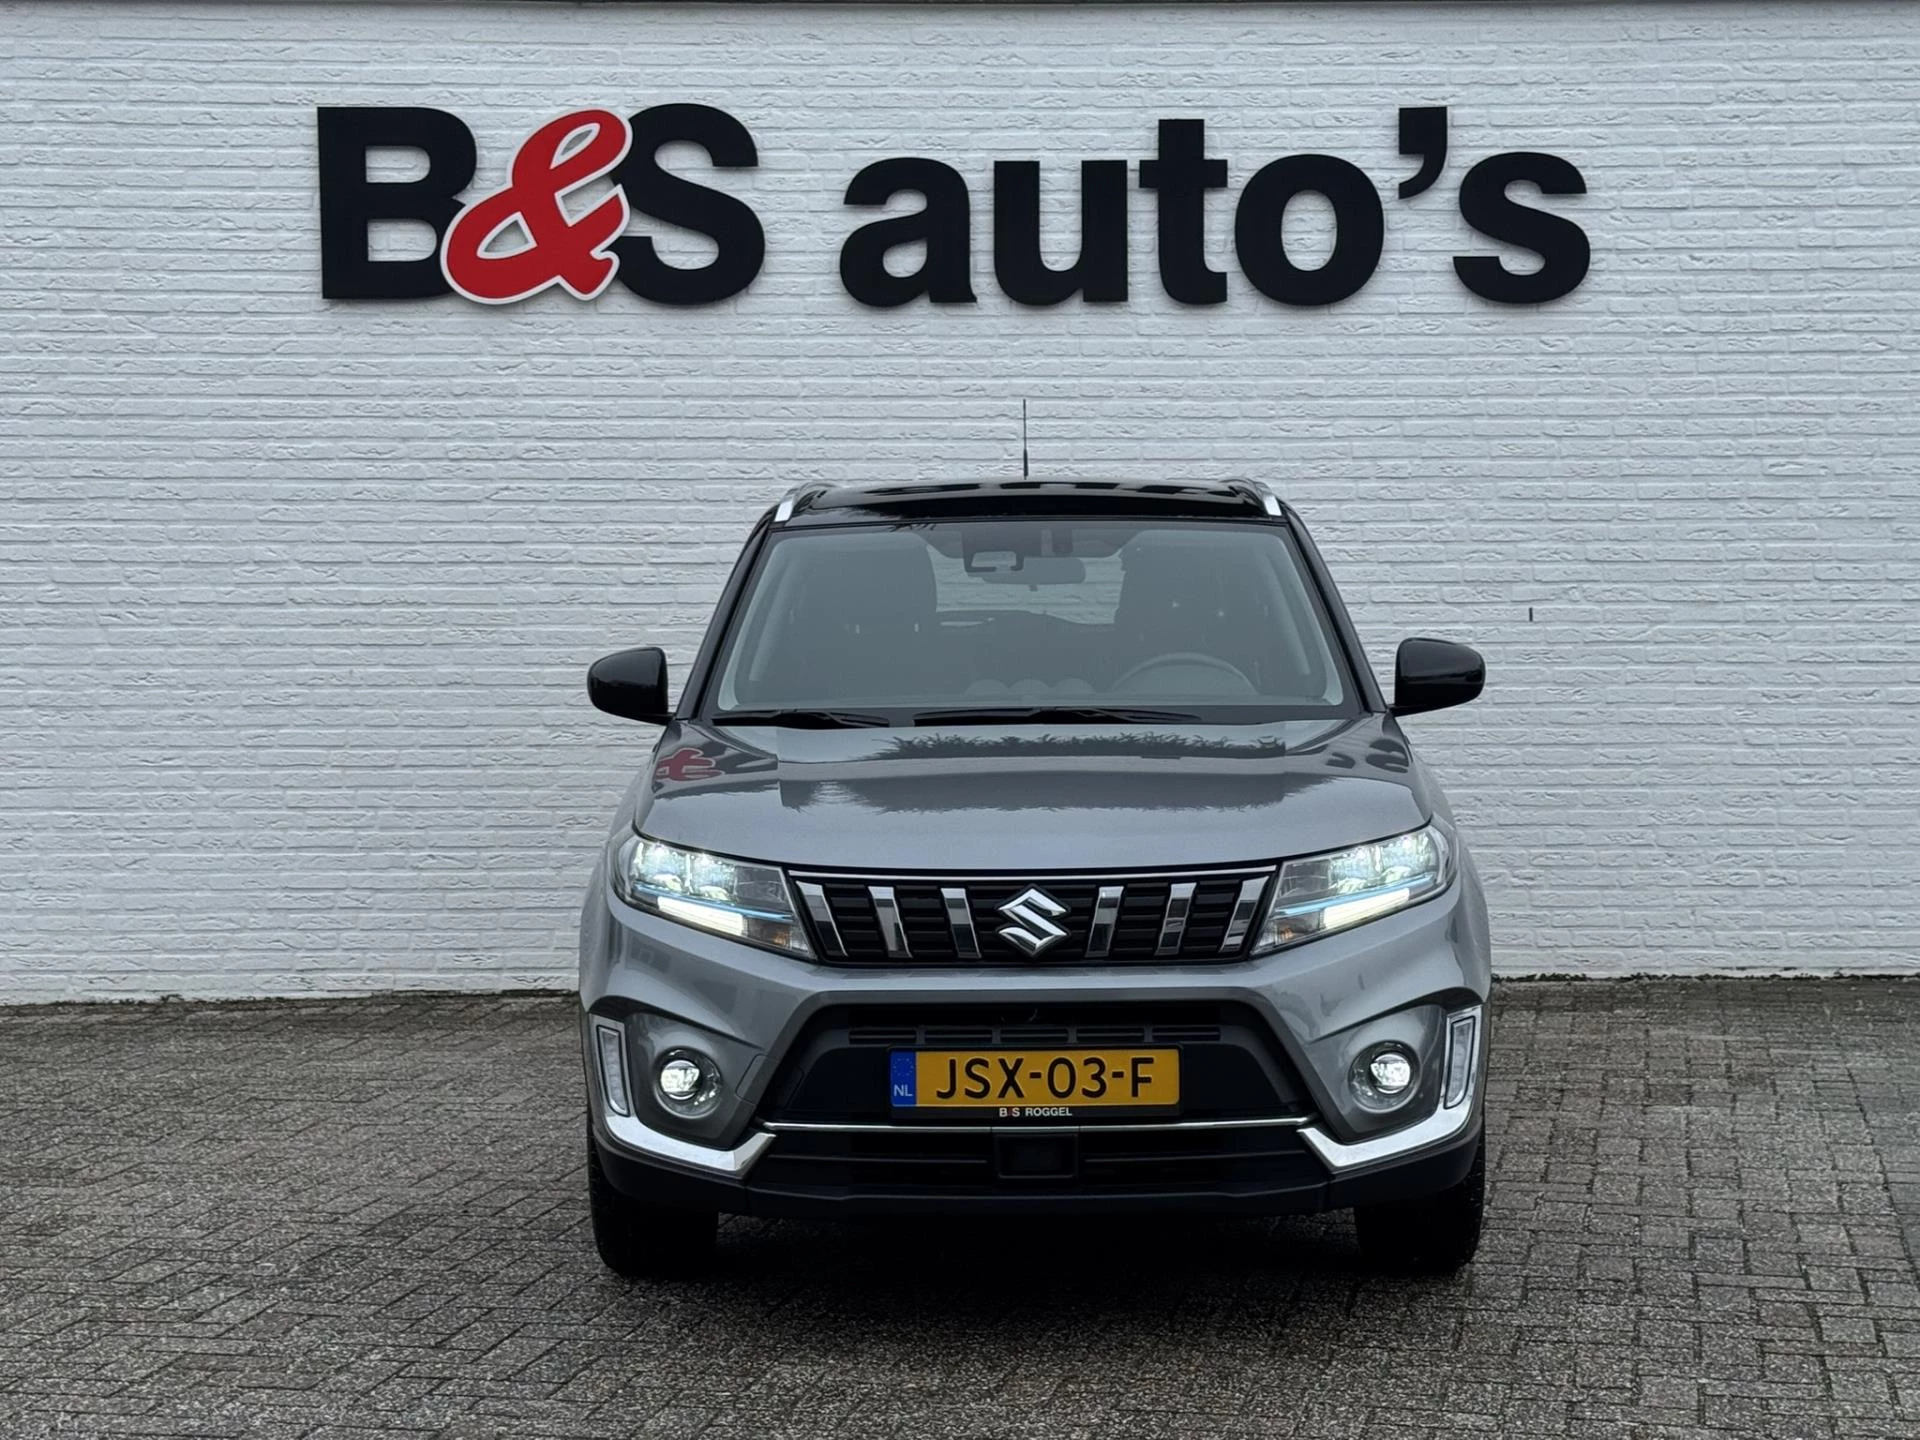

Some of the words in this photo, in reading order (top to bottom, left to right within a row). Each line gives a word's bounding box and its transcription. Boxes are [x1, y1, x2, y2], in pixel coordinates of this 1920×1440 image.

[318, 103, 765, 306] B&S
[836, 106, 1590, 307] auto's
[893, 1084, 913, 1096] NL
[935, 1057, 1154, 1098] JSX-03-F
[1025, 1107, 1072, 1116] ROGGEL
